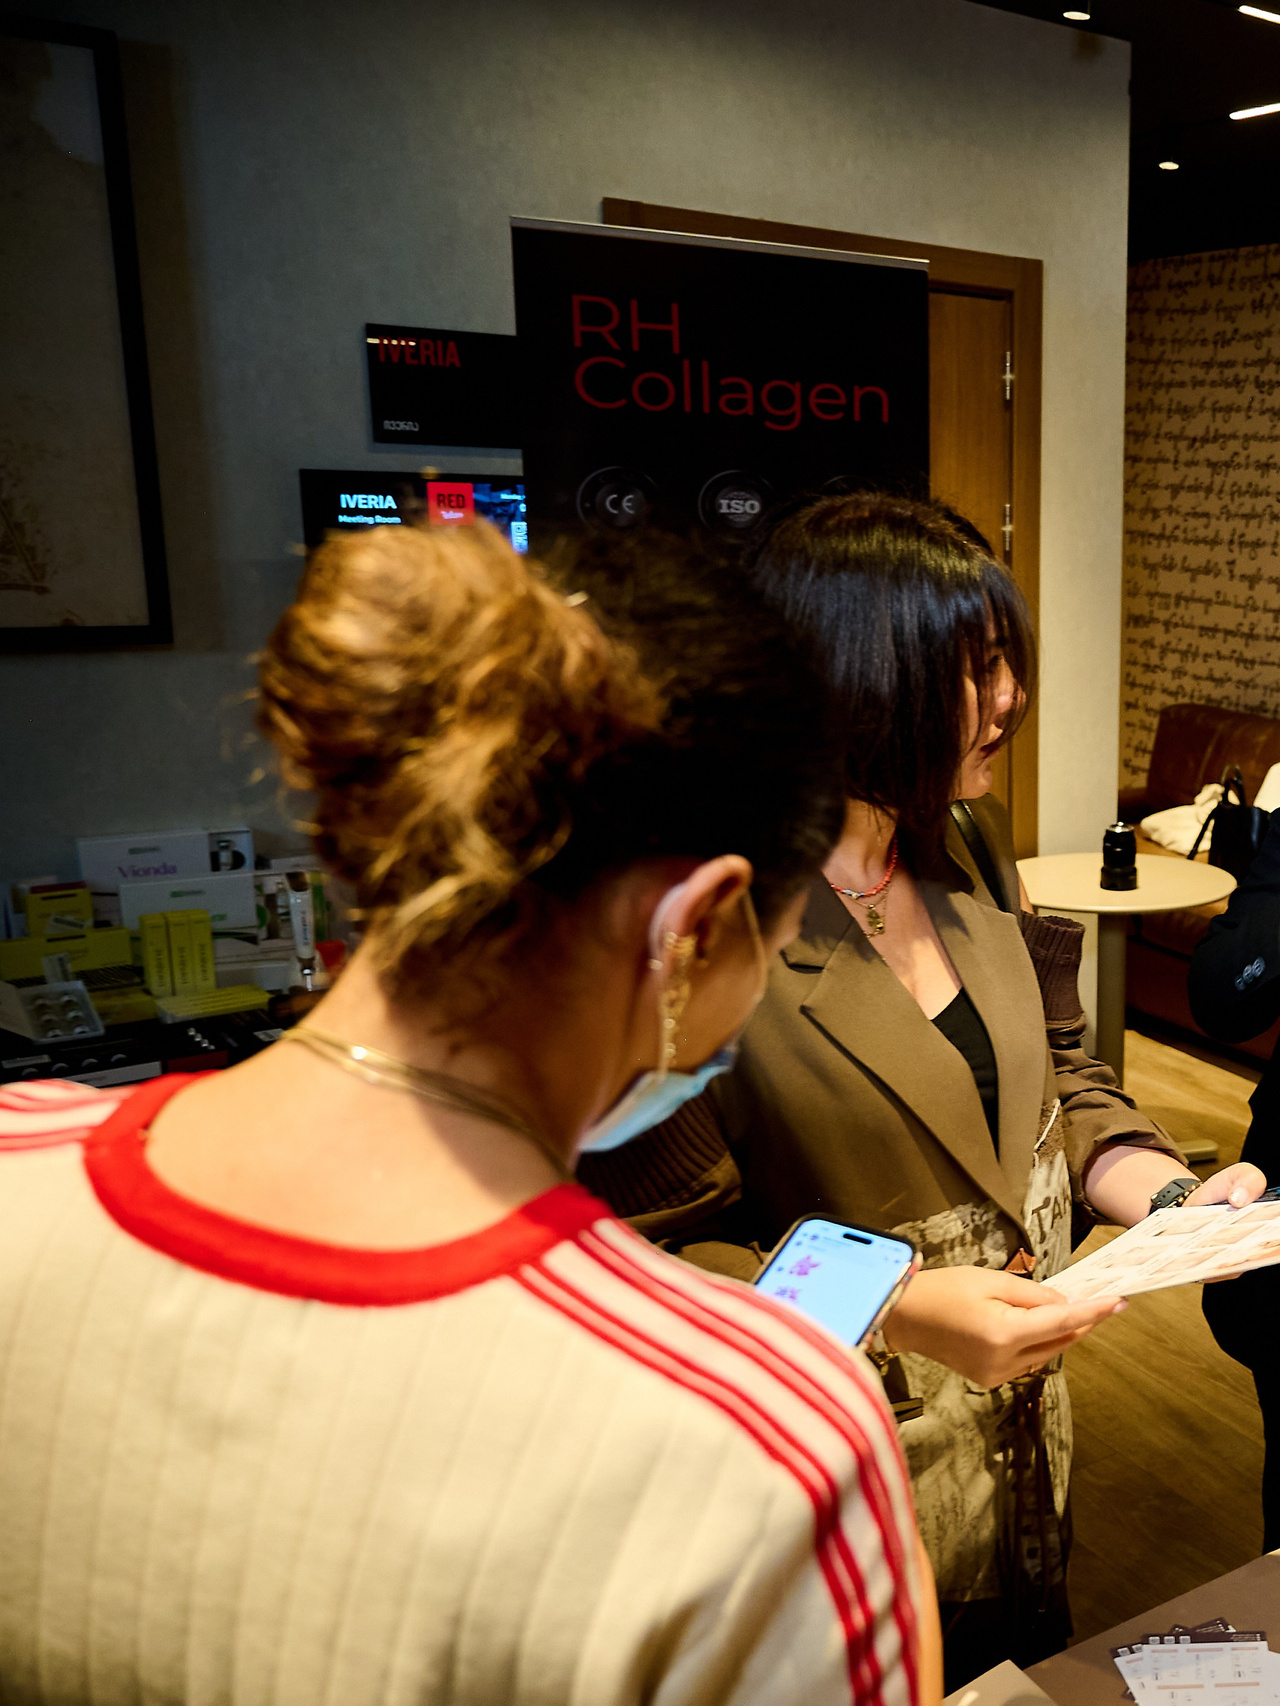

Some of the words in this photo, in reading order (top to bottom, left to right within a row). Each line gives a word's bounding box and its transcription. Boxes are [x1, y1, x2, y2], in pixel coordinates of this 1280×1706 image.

[572, 294, 680, 355] RH
[377, 335, 462, 368] IVERIA
[574, 356, 889, 431] Collagen
[339, 493, 398, 510] IVERIA
[436, 493, 466, 509] RED
[718, 499, 761, 515] ISO
[338, 514, 375, 525] Meeting
[375, 514, 402, 524] Room
